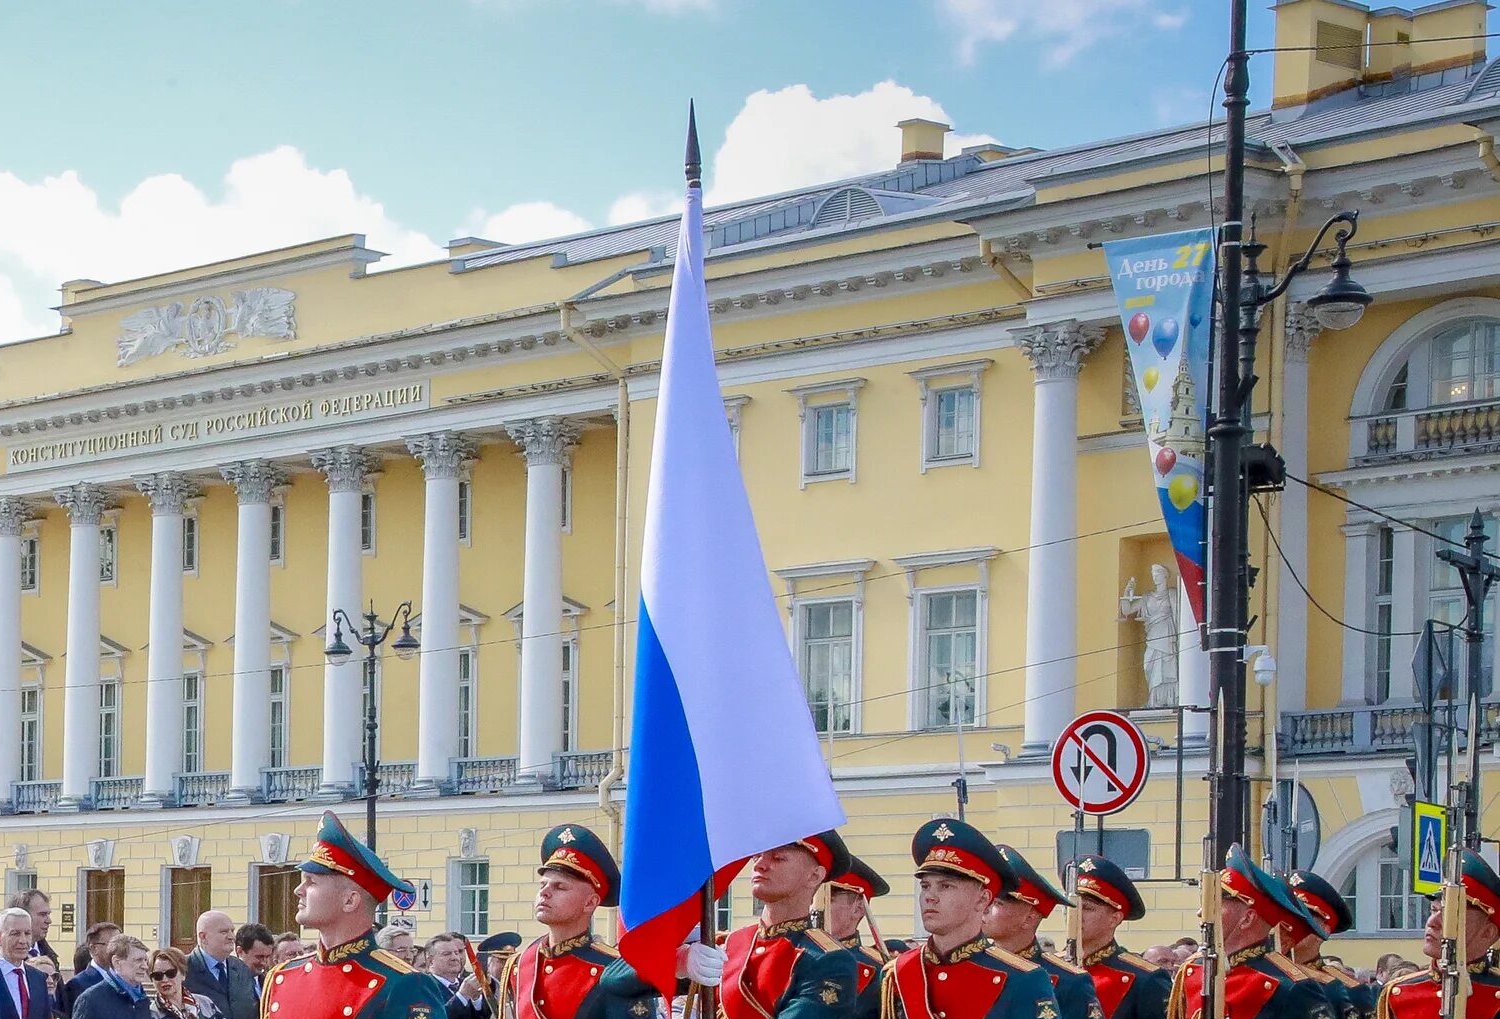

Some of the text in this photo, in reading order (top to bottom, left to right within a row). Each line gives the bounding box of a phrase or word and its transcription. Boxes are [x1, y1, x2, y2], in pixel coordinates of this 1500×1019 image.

[1117, 258, 1169, 280] День
[1135, 270, 1204, 291] города
[10, 384, 423, 465] КОНСТИТУЦИОННЫЙ СУД РОССИЙСКОЙ ФЕДЕРАЦИИ
